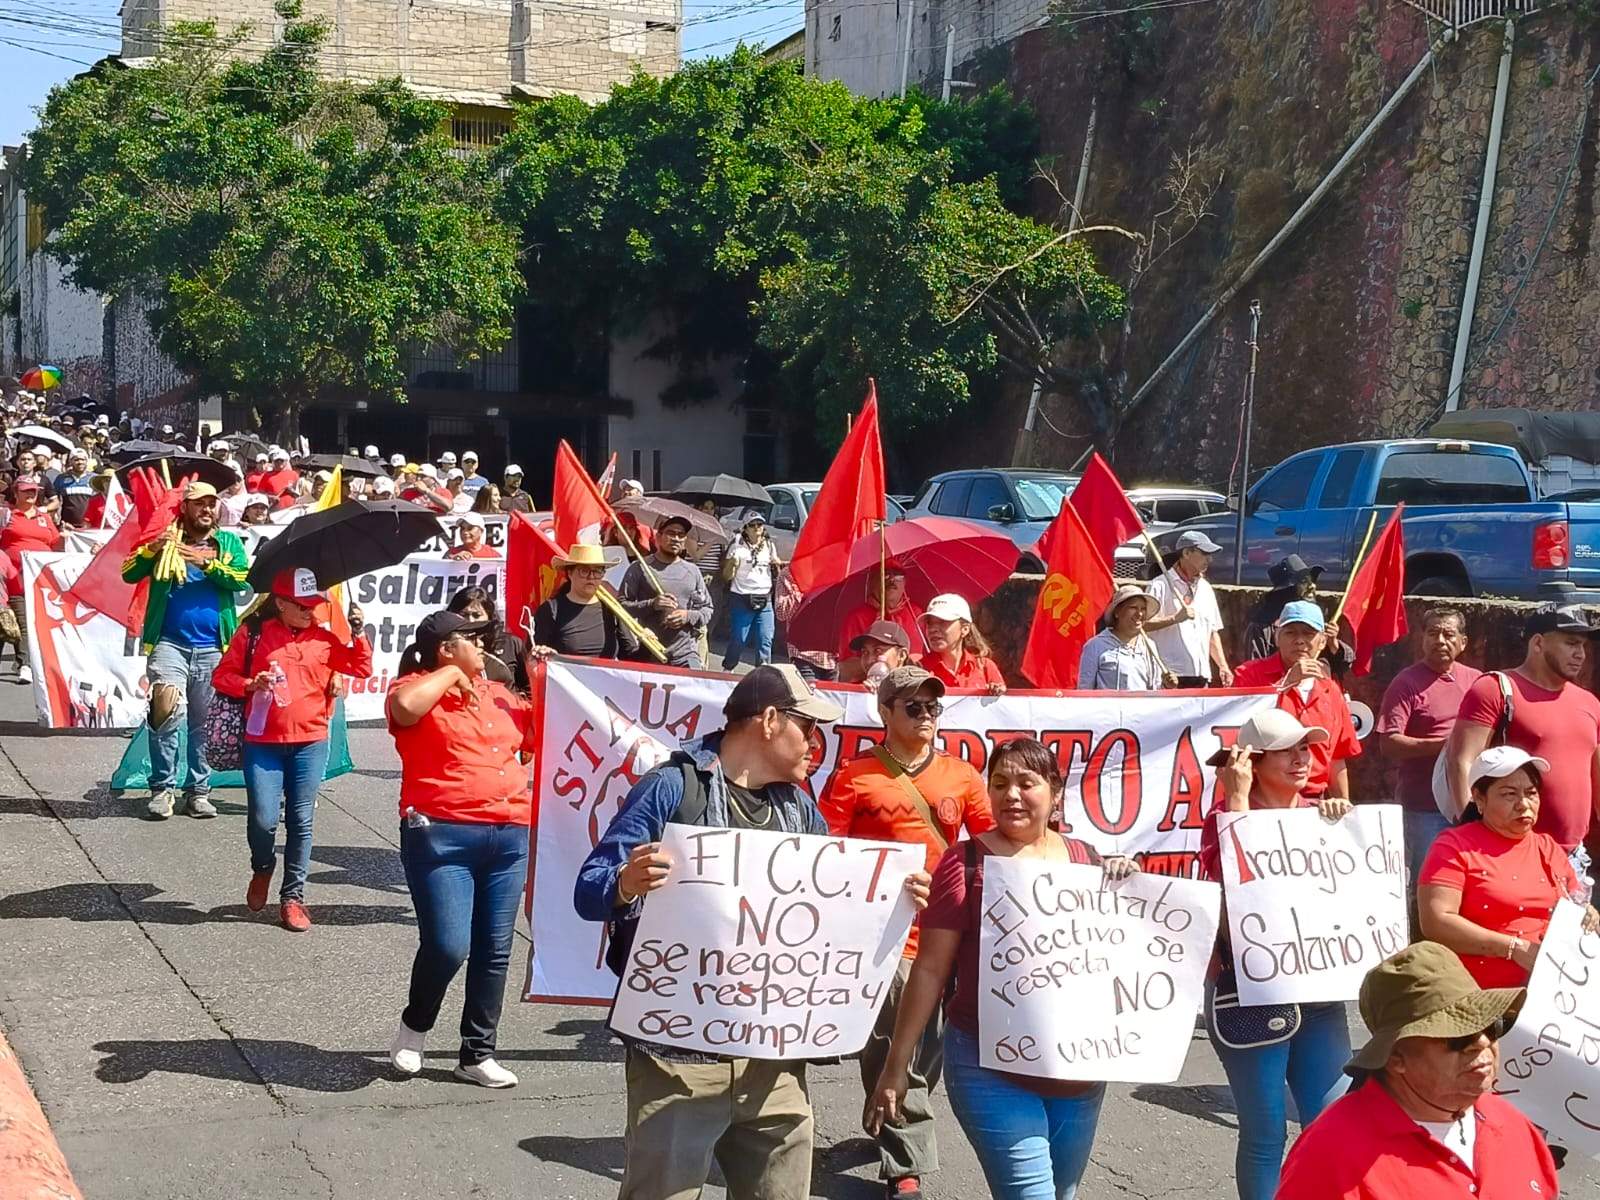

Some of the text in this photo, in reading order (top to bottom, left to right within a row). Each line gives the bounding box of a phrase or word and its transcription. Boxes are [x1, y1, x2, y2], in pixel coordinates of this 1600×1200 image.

[678, 830, 742, 887] El
[1219, 815, 1356, 895] Trabajo
[735, 895, 820, 947] NO
[983, 872, 1192, 948] El Contrato
[699, 942, 863, 992] negocia
[990, 918, 1125, 973] colectivo
[1240, 906, 1364, 983] Salario
[693, 976, 850, 1016] respeta
[990, 948, 1110, 1008] respeta
[1112, 971, 1175, 1016] NO
[702, 1009, 840, 1057] cumple
[1057, 1025, 1142, 1064] vende
